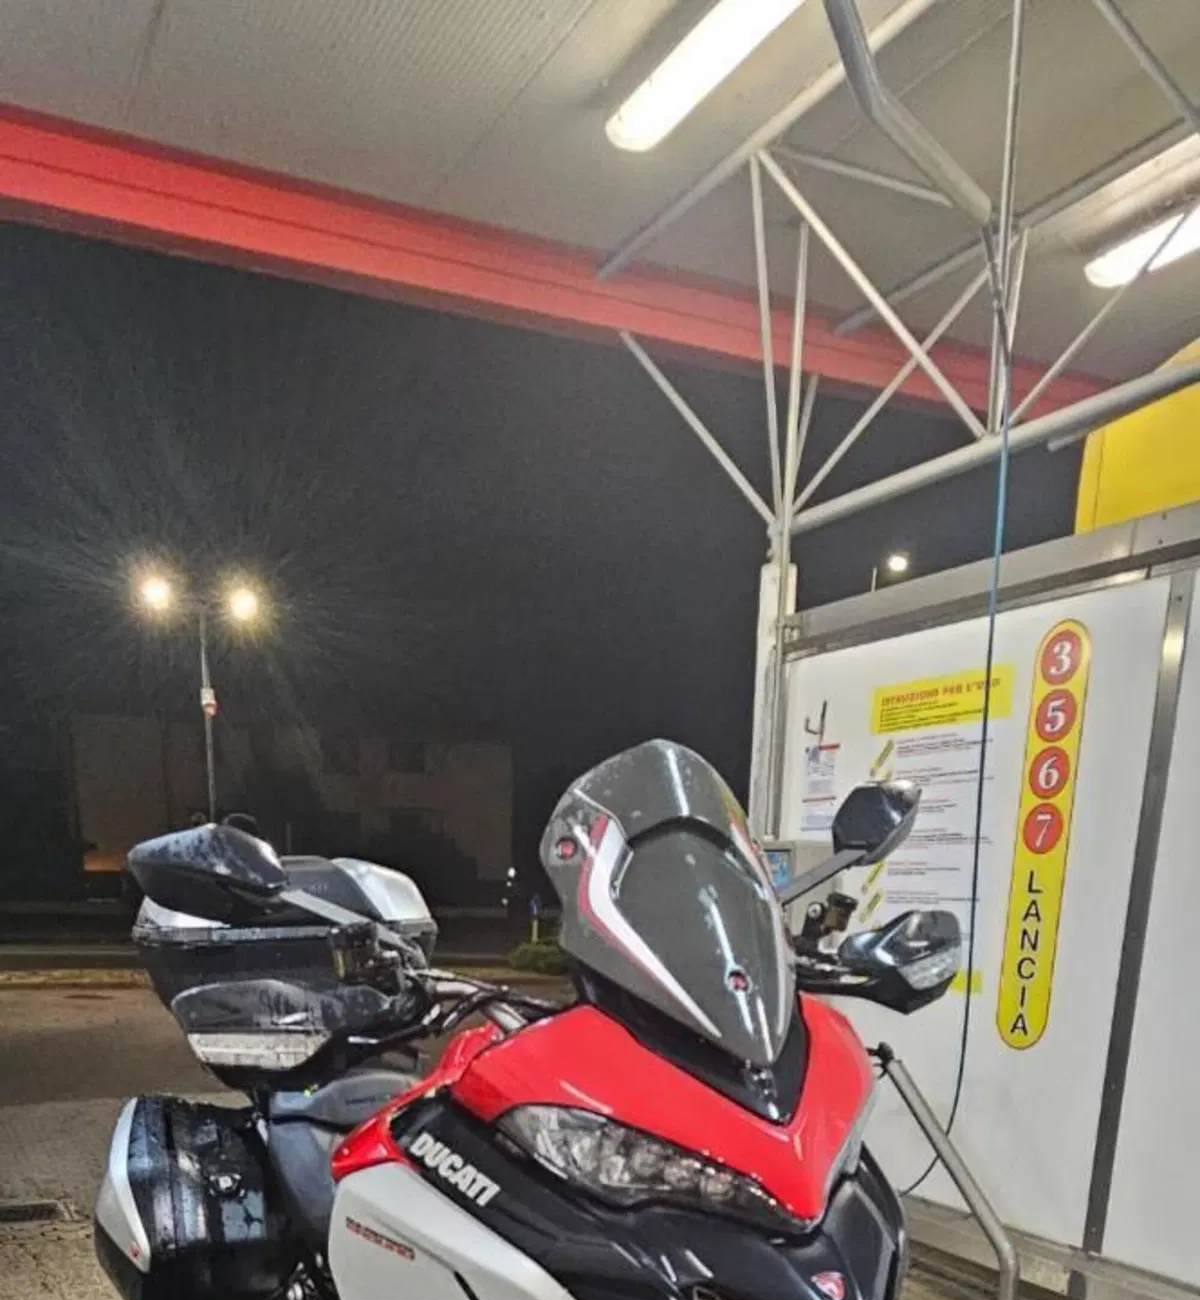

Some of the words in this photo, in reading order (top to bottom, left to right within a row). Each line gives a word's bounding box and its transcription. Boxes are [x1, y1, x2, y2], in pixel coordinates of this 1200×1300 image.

[1050, 641, 1073, 676] 3
[1044, 698, 1067, 733] 5
[1038, 756, 1059, 789] 6
[1034, 813, 1053, 848] 7
[1010, 870, 1044, 1037] LANCIA
[409, 1133, 501, 1207] DUCATI
